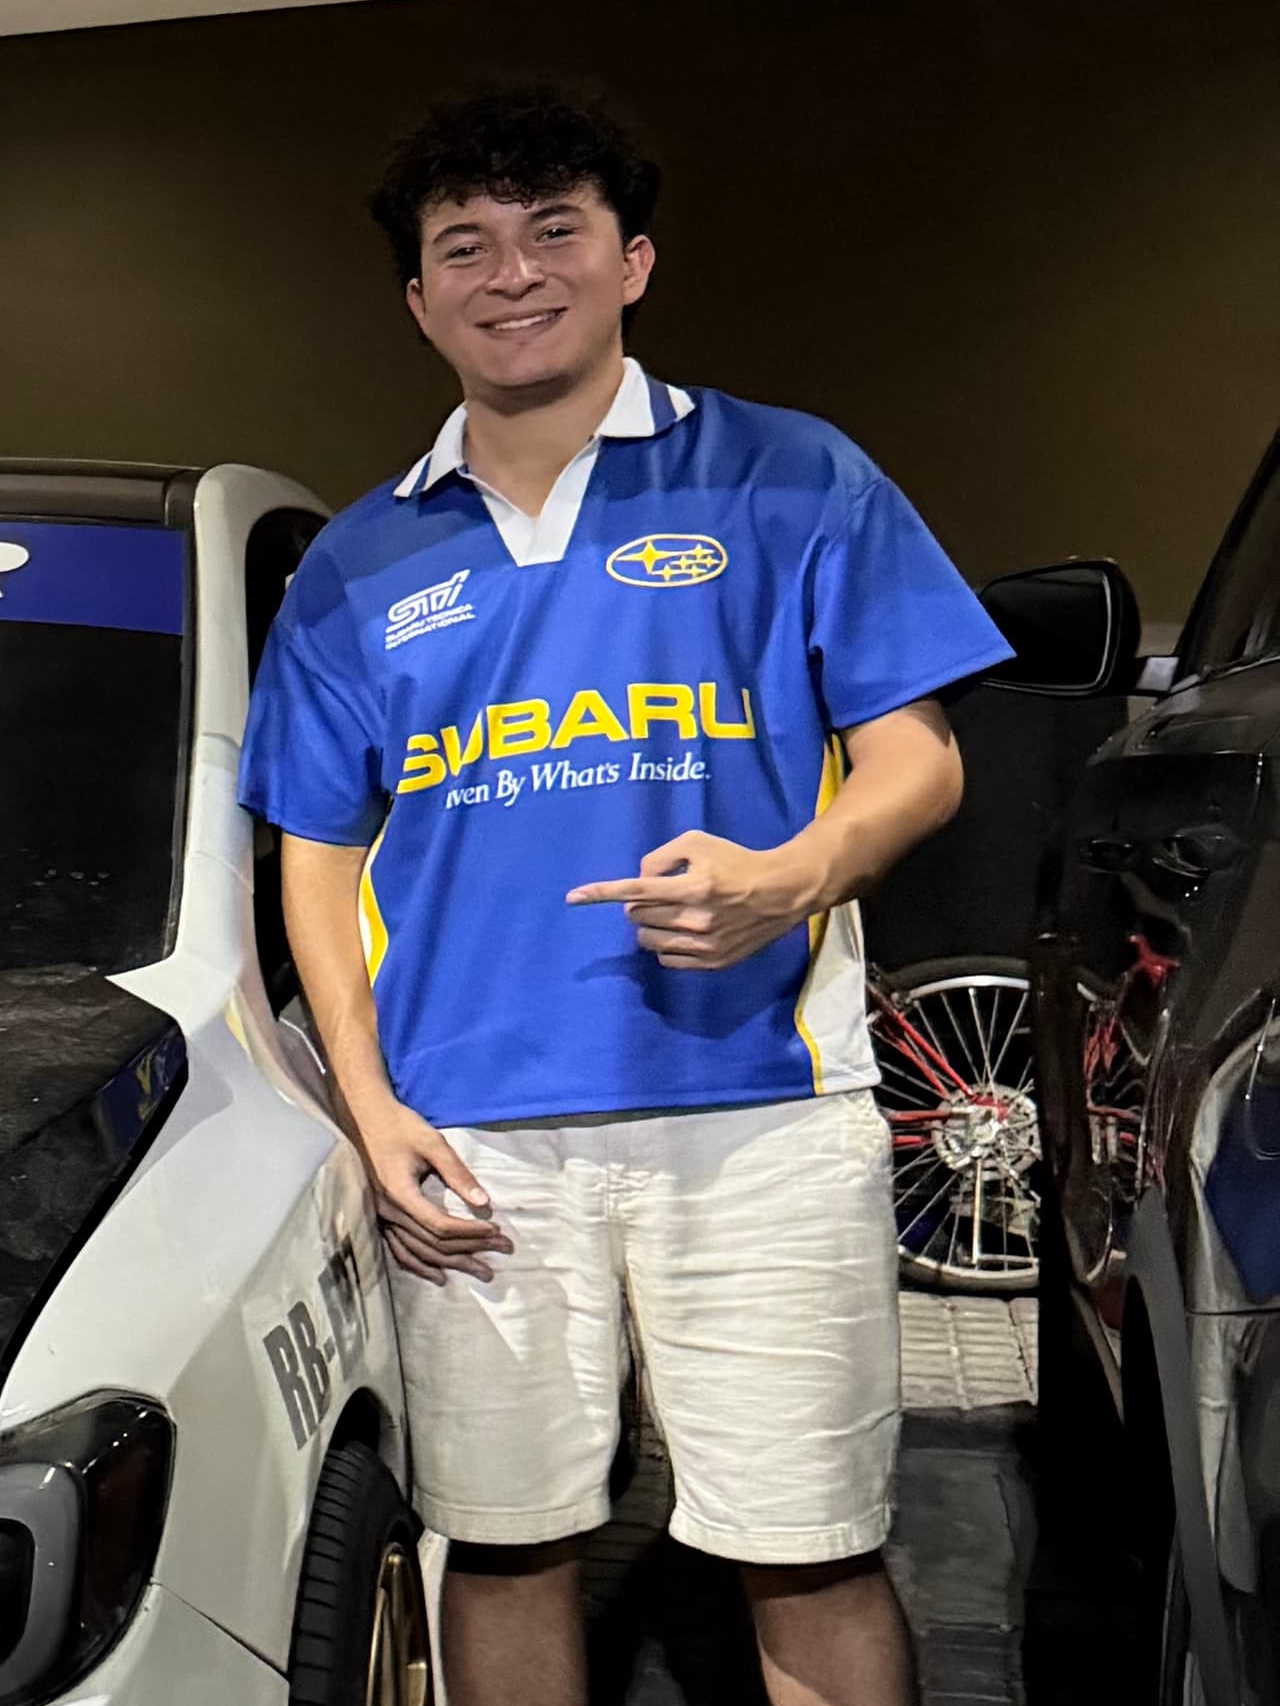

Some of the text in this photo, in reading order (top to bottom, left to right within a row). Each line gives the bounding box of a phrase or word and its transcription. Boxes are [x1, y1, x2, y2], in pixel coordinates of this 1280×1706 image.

[397, 682, 756, 794] SUBARU
[495, 768, 527, 807] By
[530, 759, 621, 792] What's
[628, 750, 712, 782] Inside.
